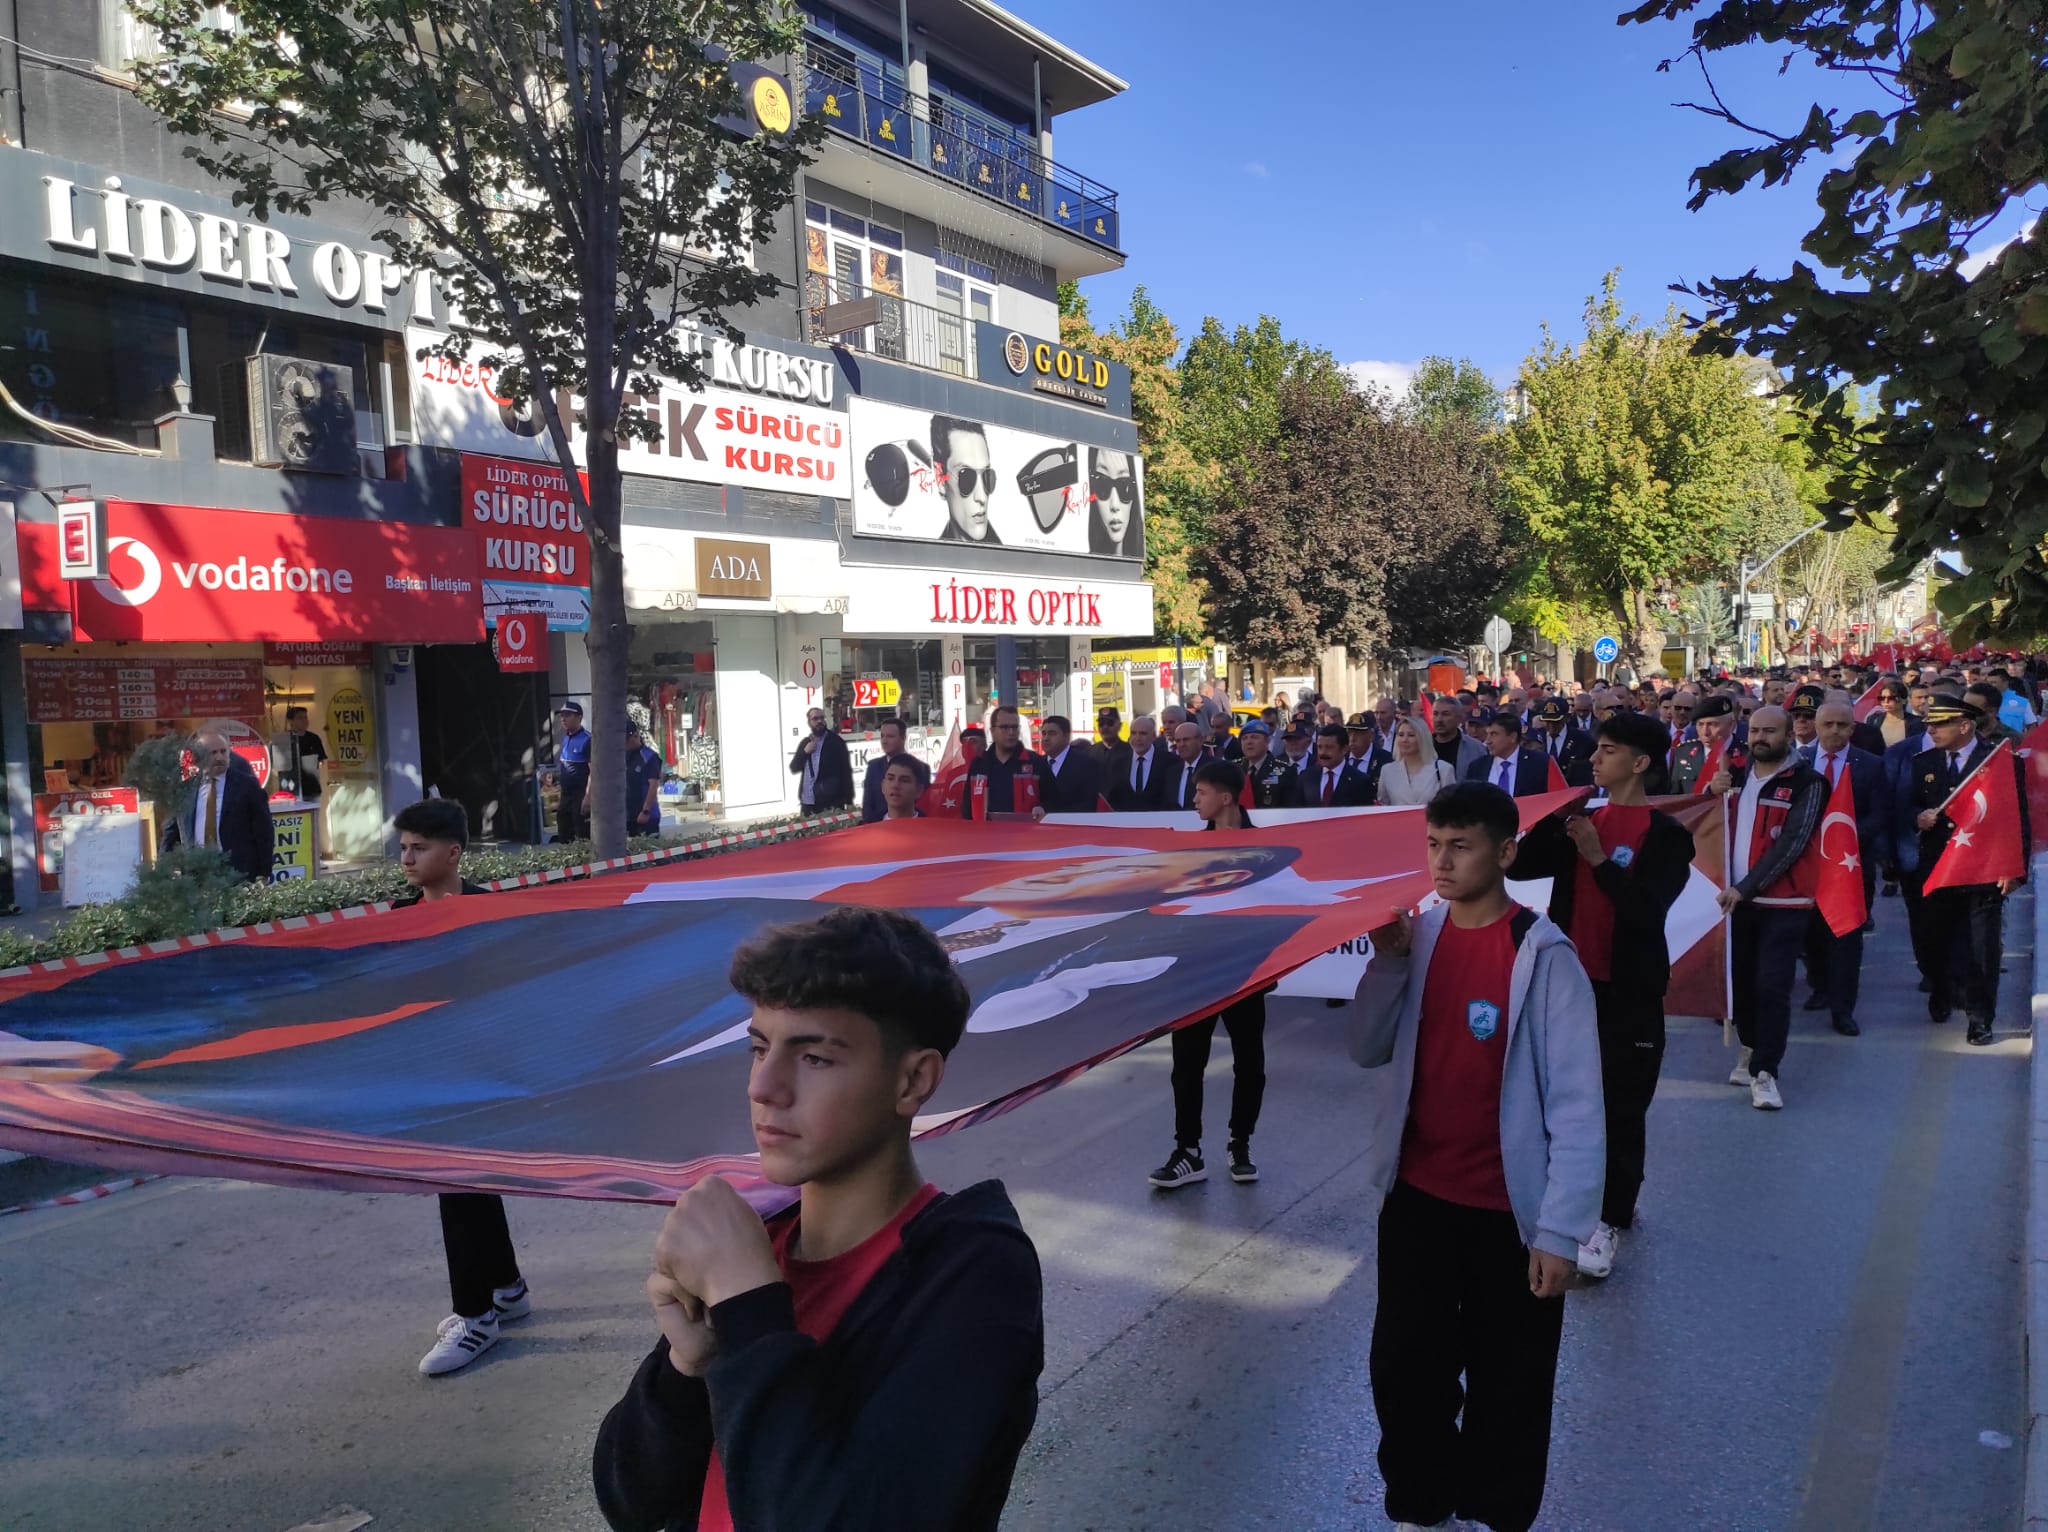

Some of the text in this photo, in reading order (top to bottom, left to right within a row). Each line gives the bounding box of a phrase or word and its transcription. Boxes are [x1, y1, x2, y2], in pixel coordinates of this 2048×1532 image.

[42, 176, 298, 299] LİDER
[712, 334, 835, 403] KURSU
[1034, 343, 1109, 388] GOLD
[715, 405, 842, 449] SÜRÜCÜ
[725, 445, 835, 482] KURSU
[486, 465, 568, 492] LİDER OPTİ
[486, 537, 575, 576] KURSU
[172, 556, 353, 594] vodafone
[709, 555, 762, 581] ADA
[385, 573, 472, 595] Başkan İletişim
[663, 592, 694, 607] ADA
[823, 599, 849, 614] ADA
[929, 577, 1102, 625] LİDER OPTİK
[295, 654, 346, 665] NOKTASI
[501, 655, 534, 664] vodafone
[334, 706, 365, 724] YENİ
[338, 729, 364, 743] HAT
[339, 746, 358, 760] 700
[272, 816, 303, 828] RASIZ
[273, 827, 300, 848] Nİ
[272, 850, 298, 866] AT
